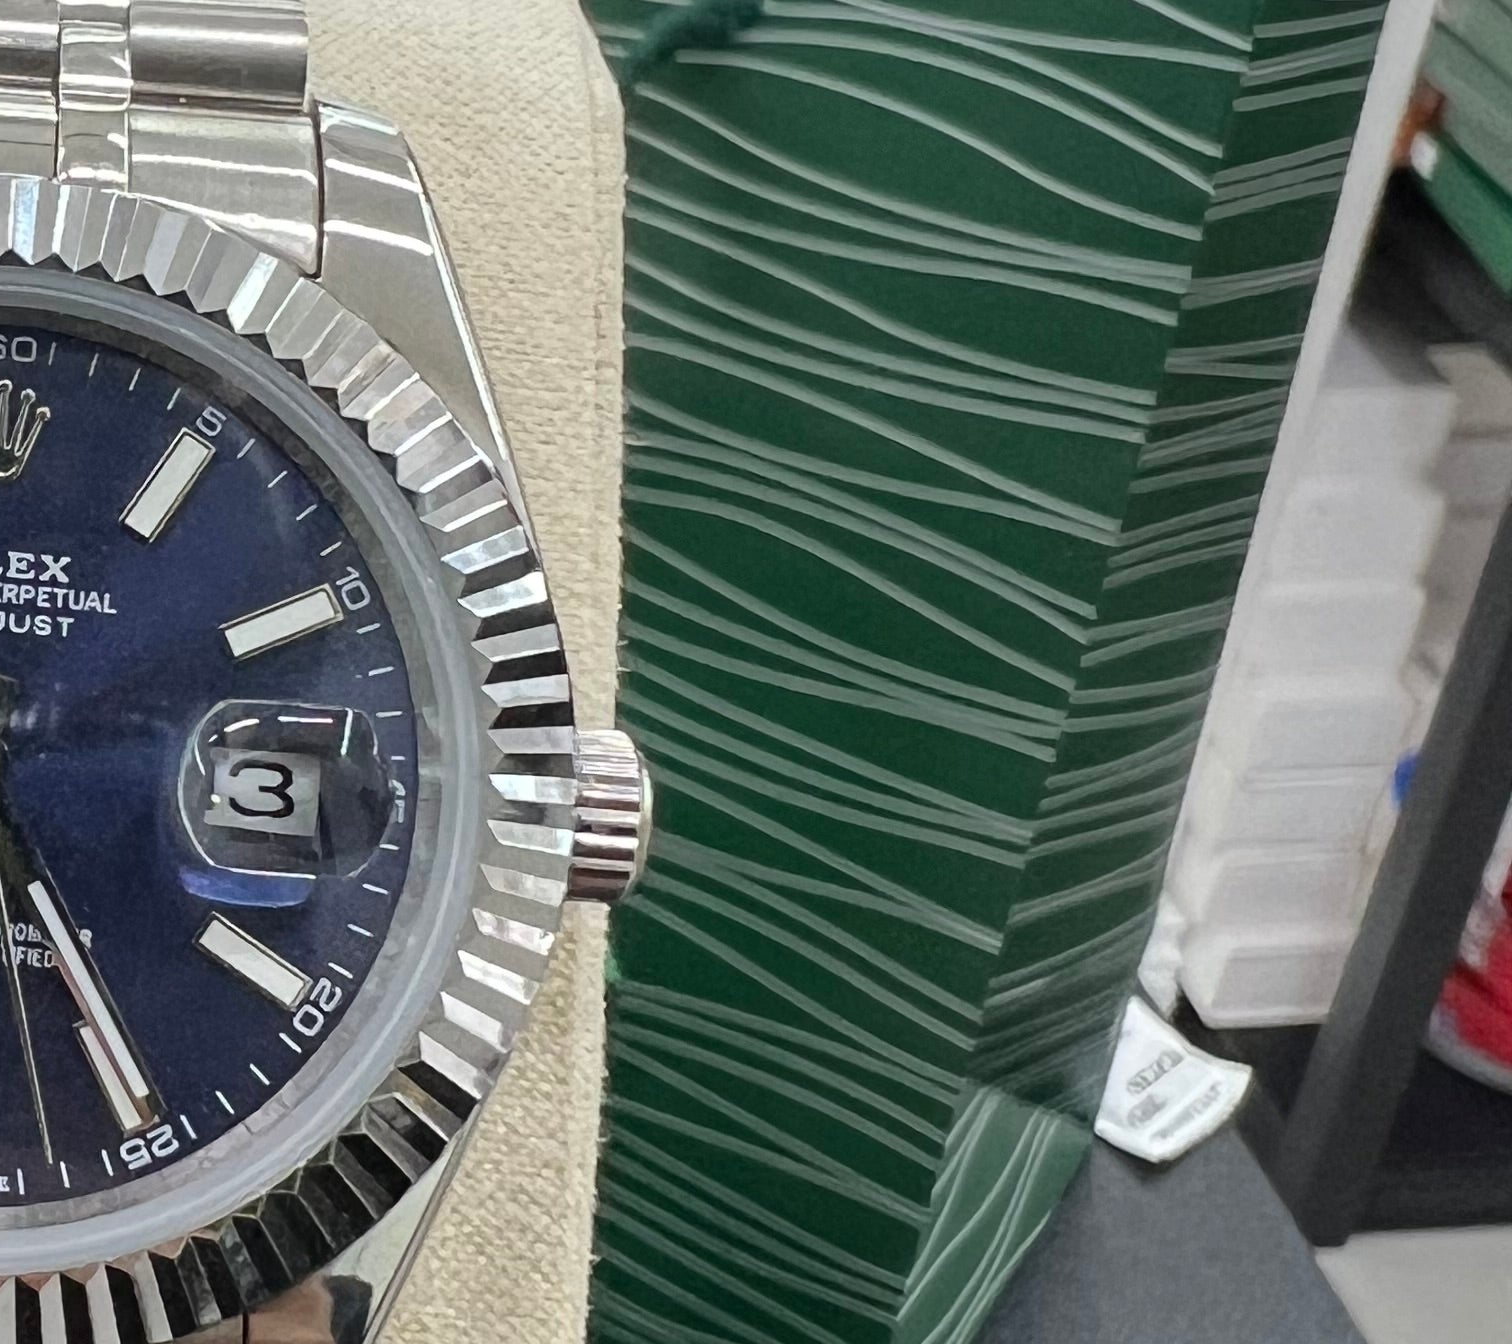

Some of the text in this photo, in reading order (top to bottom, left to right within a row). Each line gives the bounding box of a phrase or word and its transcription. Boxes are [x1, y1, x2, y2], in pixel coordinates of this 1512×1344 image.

[196, 406, 227, 437] 5
[336, 566, 371, 610] 10
[229, 759, 295, 819] 3
[292, 977, 343, 1037] 20
[119, 1124, 179, 1170] 25
